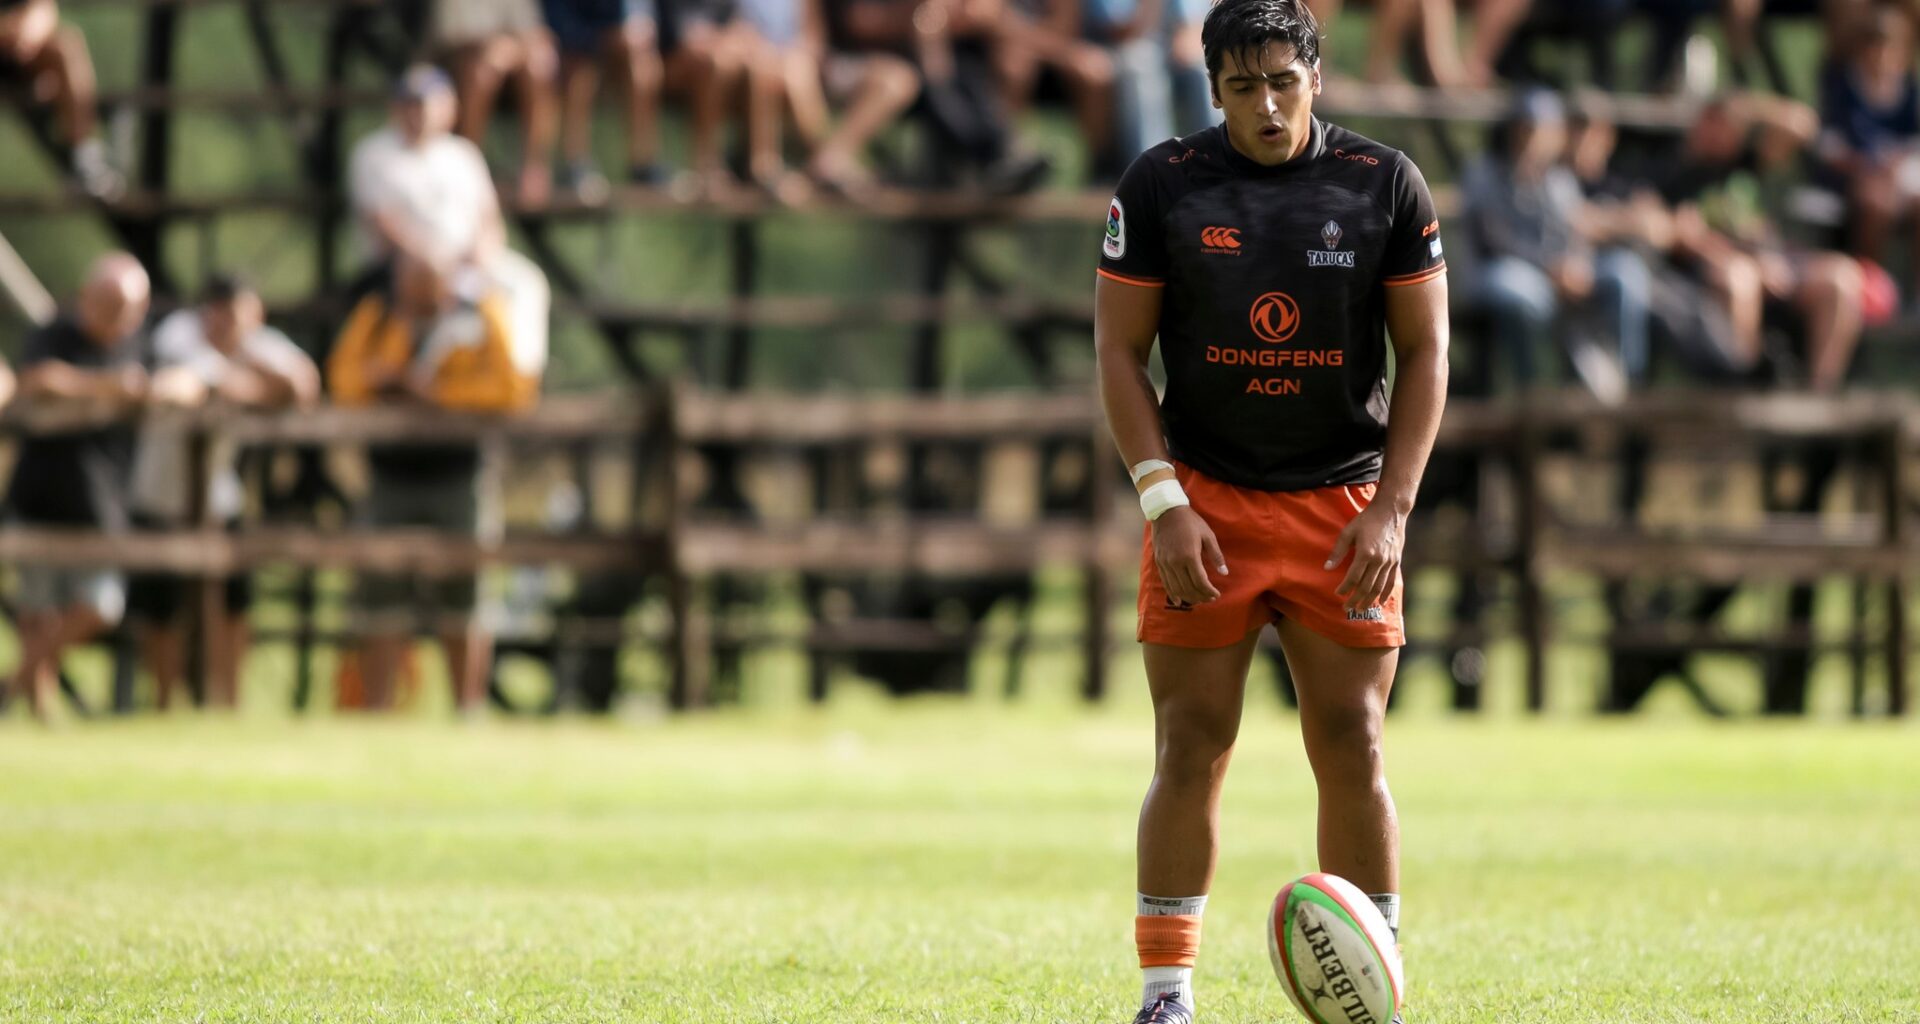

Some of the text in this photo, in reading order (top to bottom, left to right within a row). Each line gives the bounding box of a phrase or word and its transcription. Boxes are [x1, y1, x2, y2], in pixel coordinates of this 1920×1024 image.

[1307, 250, 1355, 267] TARUCAS
[1206, 345, 1343, 367] DONGFENG
[1246, 378, 1301, 395] AGN
